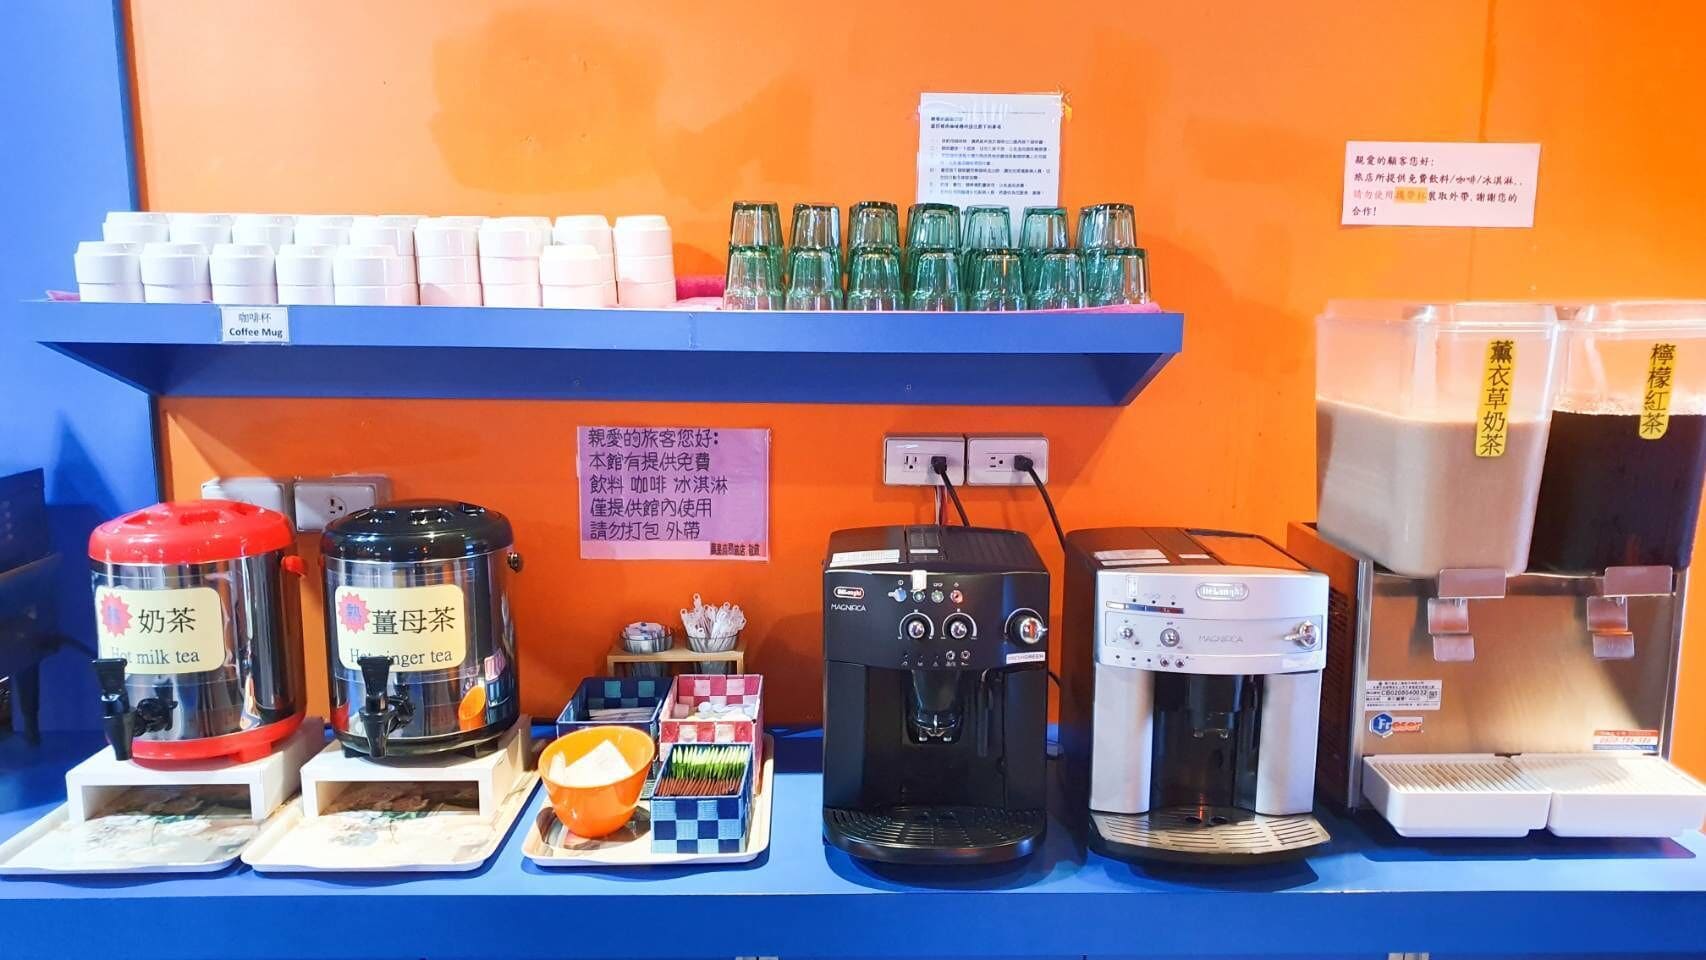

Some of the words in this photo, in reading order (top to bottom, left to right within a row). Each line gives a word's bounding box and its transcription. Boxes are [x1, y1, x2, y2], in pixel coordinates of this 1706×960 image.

[238, 311, 272, 323] 咖啡杯
[229, 327, 259, 336] Coffee
[261, 328, 283, 339] Mug
[1641, 343, 1677, 435] 檸檬紅茶
[588, 428, 719, 448] 親愛的旅客您好:
[589, 451, 711, 471] 本館有提供免費
[589, 474, 624, 494] 飲料
[630, 475, 667, 494] 咖啡
[674, 475, 729, 495] 冰淇淋
[590, 498, 712, 518] 僅提供館內使用
[590, 520, 660, 540] 請勿打包
[666, 520, 701, 540] 外帶
[138, 607, 197, 634] 奶茶
[370, 606, 456, 635] 薑母茶
[137, 649, 170, 665] milk
[175, 648, 201, 664] tea
[430, 650, 453, 664] tea
